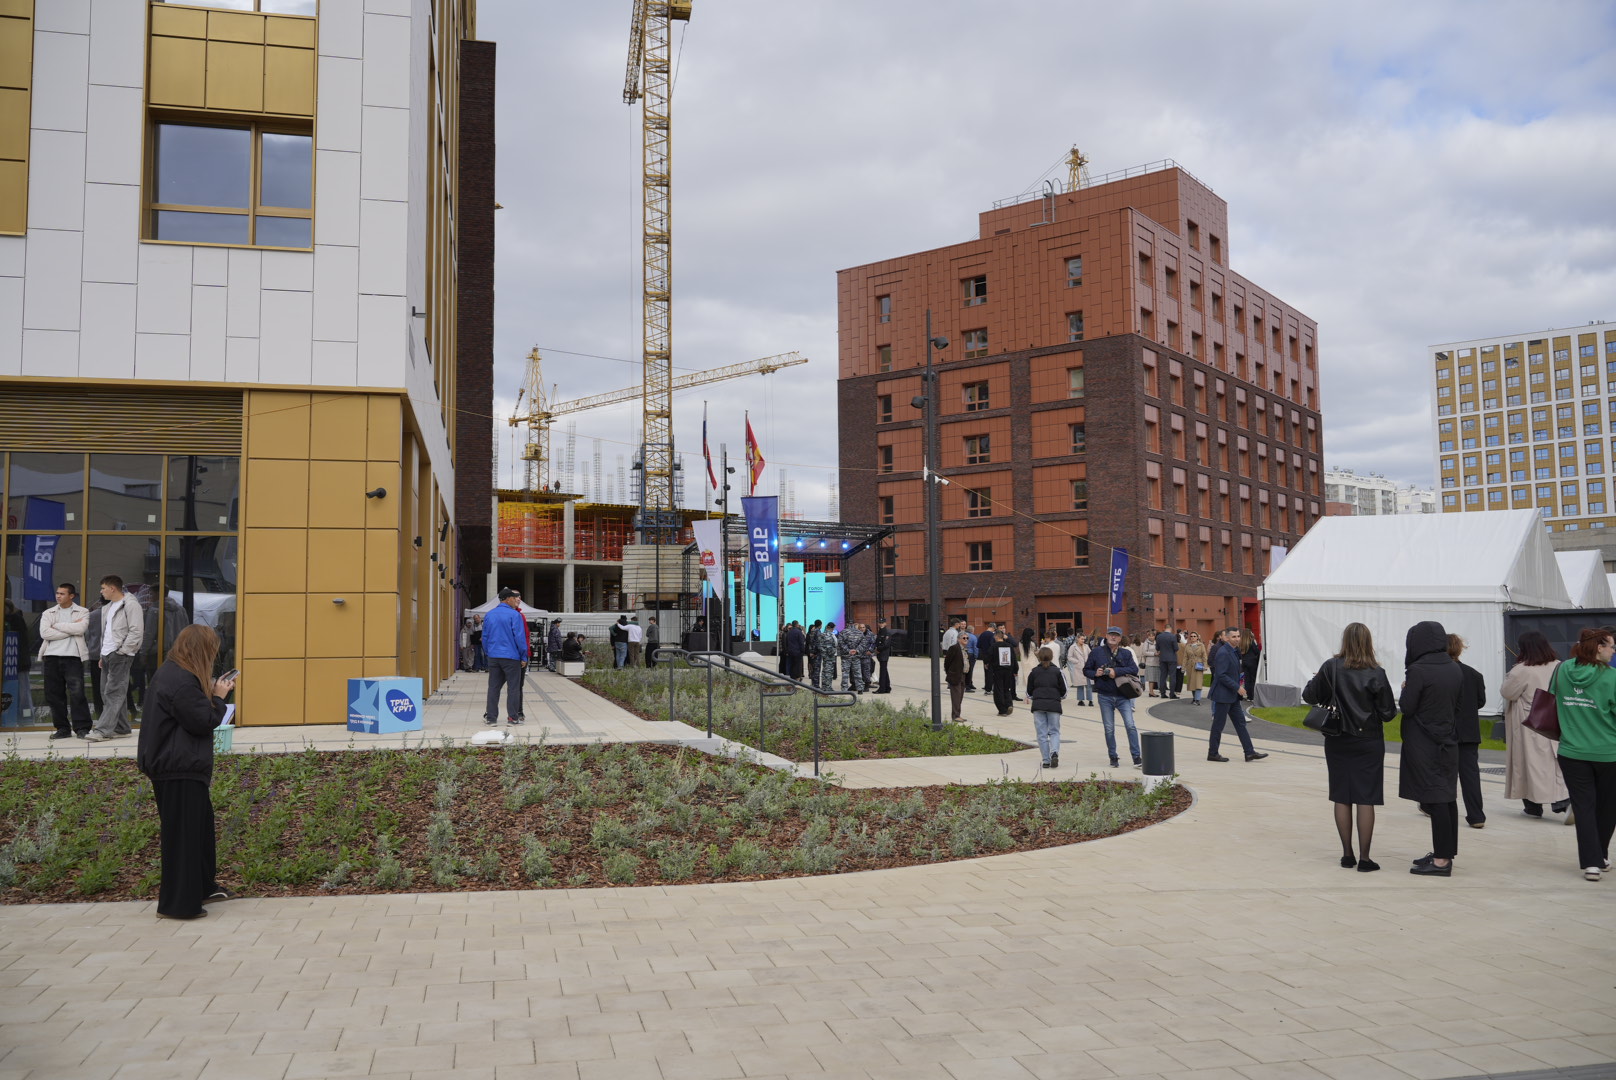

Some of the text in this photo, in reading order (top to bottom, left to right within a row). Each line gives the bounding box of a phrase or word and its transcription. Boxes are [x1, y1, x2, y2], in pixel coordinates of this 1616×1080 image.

[34, 535, 56, 563] ВТ
[1113, 568, 1122, 591] ВТБ
[390, 698, 409, 707] ТРУД
[392, 704, 414, 713] КРУТ
